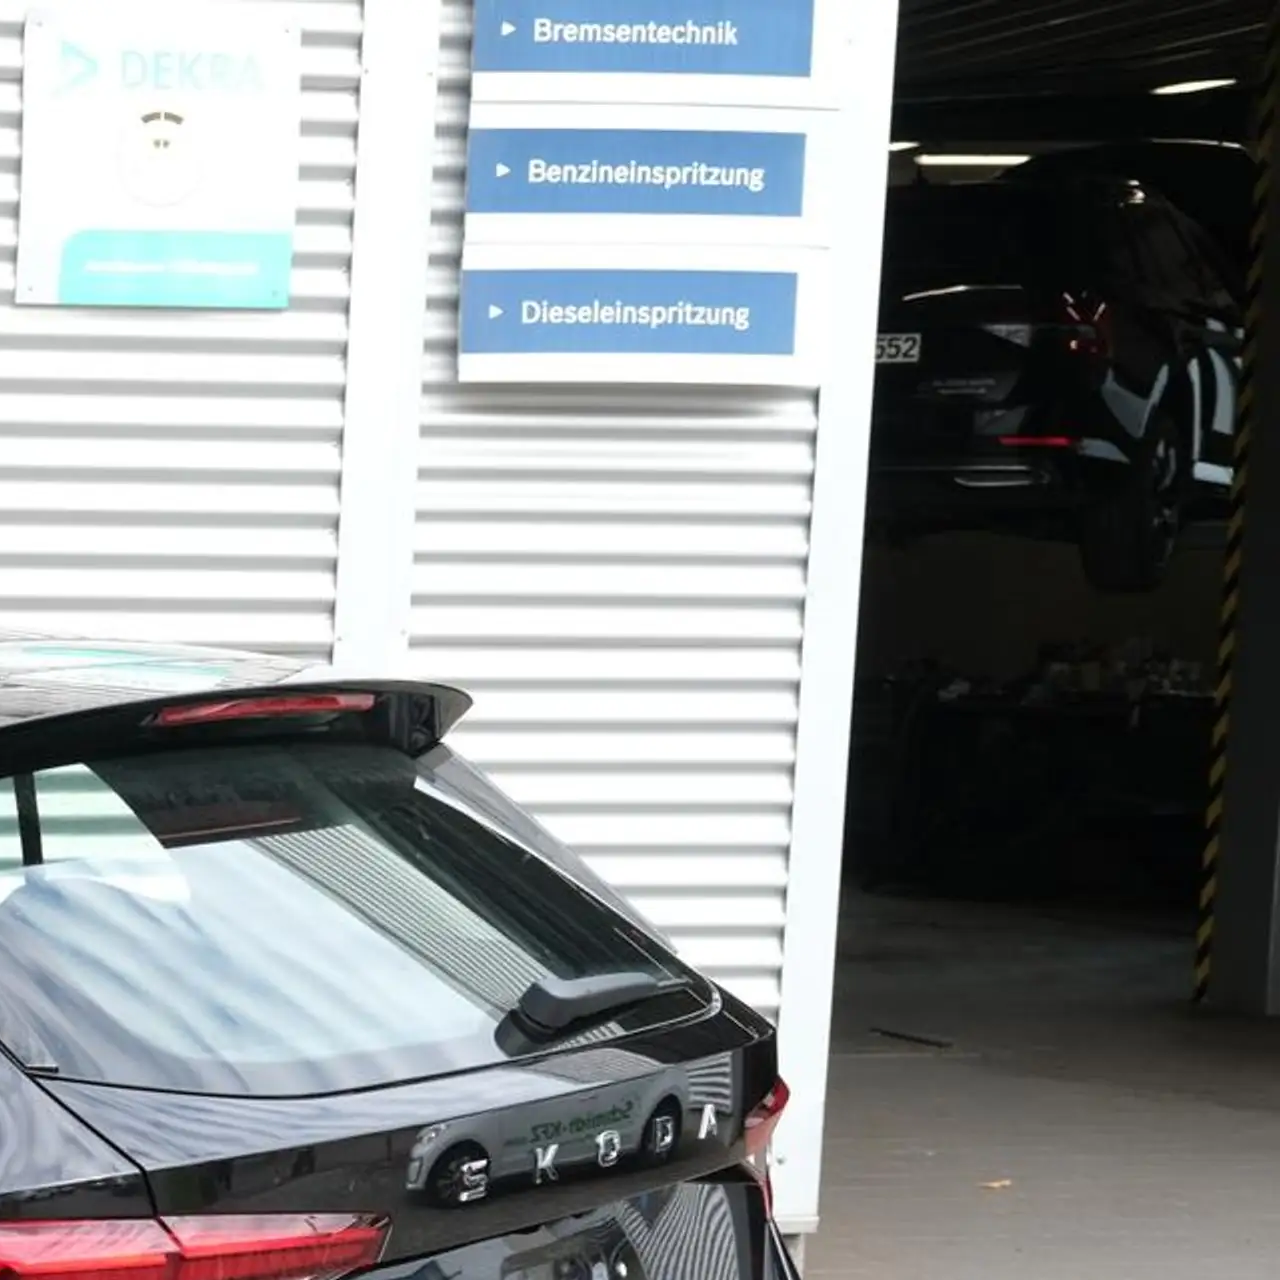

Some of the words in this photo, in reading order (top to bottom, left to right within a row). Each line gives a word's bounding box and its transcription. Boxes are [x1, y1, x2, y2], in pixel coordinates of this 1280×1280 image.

[533, 18, 738, 45] Bremsentechnik
[527, 159, 765, 192] Benzineinspritzung
[521, 300, 751, 331] Dieseleinspritzung
